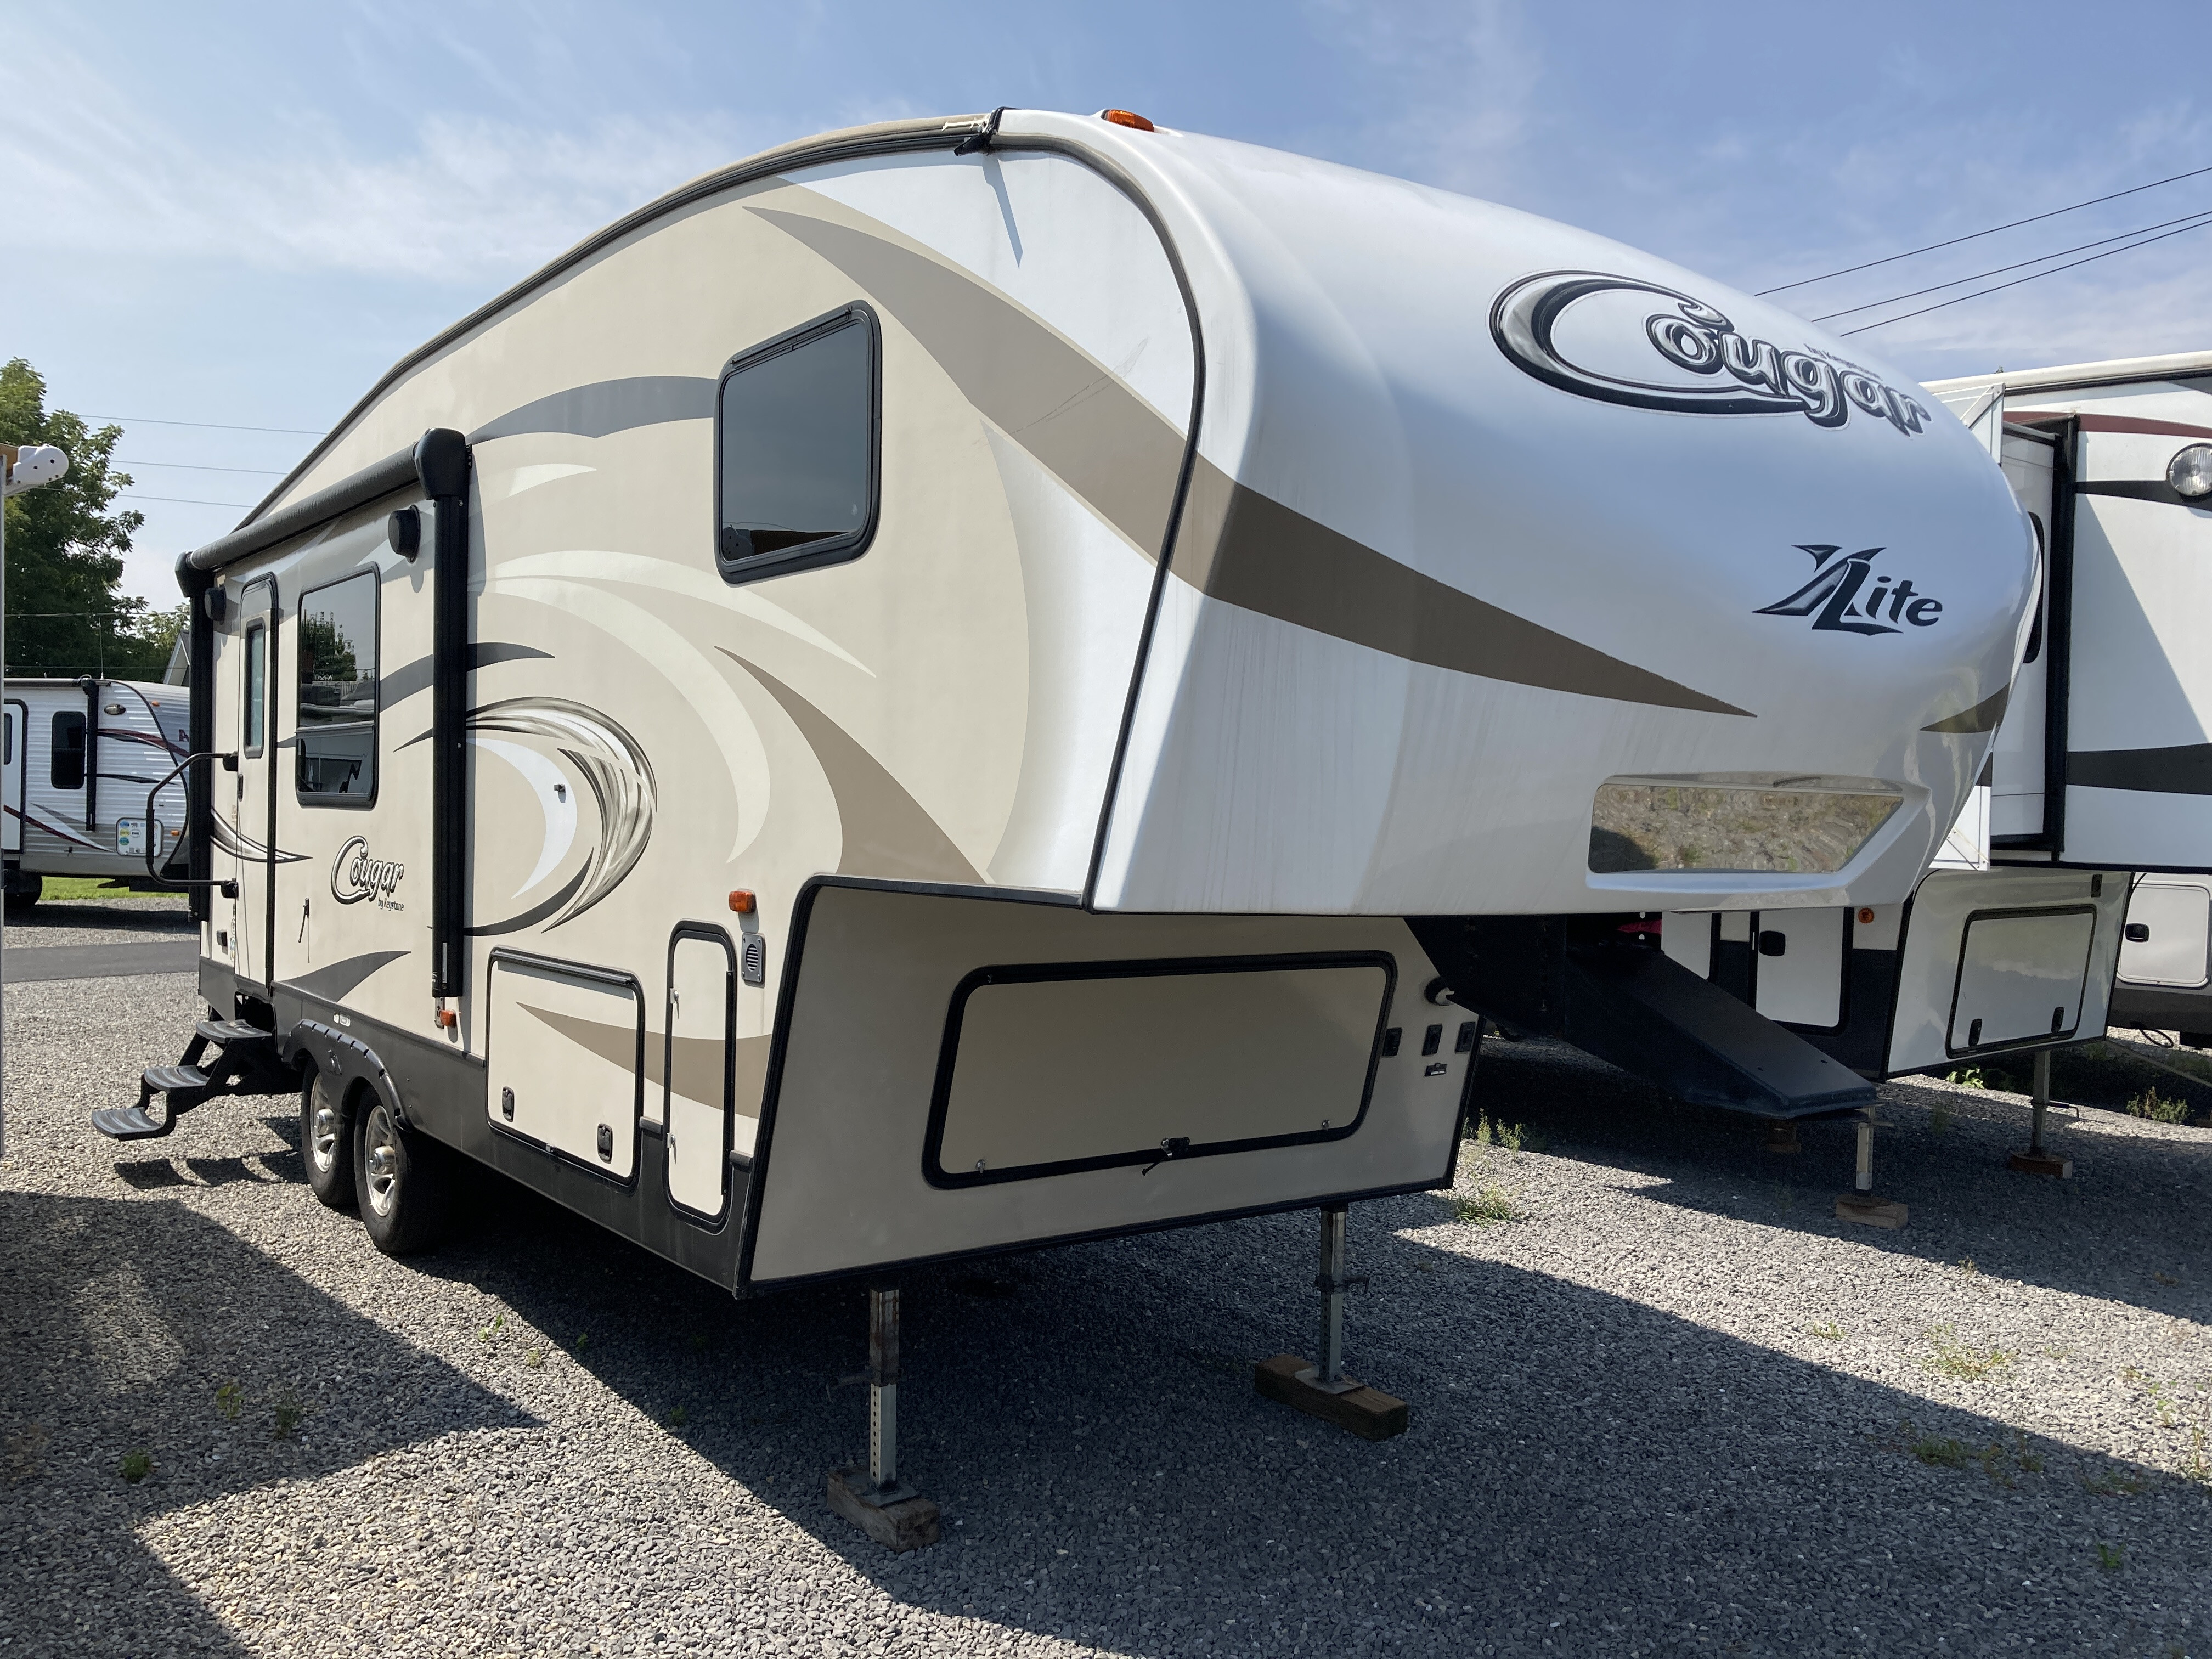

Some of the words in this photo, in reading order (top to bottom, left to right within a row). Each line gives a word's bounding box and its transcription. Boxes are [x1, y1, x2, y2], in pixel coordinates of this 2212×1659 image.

[1487, 269, 1932, 436] Cougar
[330, 835, 404, 905] Cougar
[378, 896, 383, 910] by
[384, 898, 404, 911] Keystone
